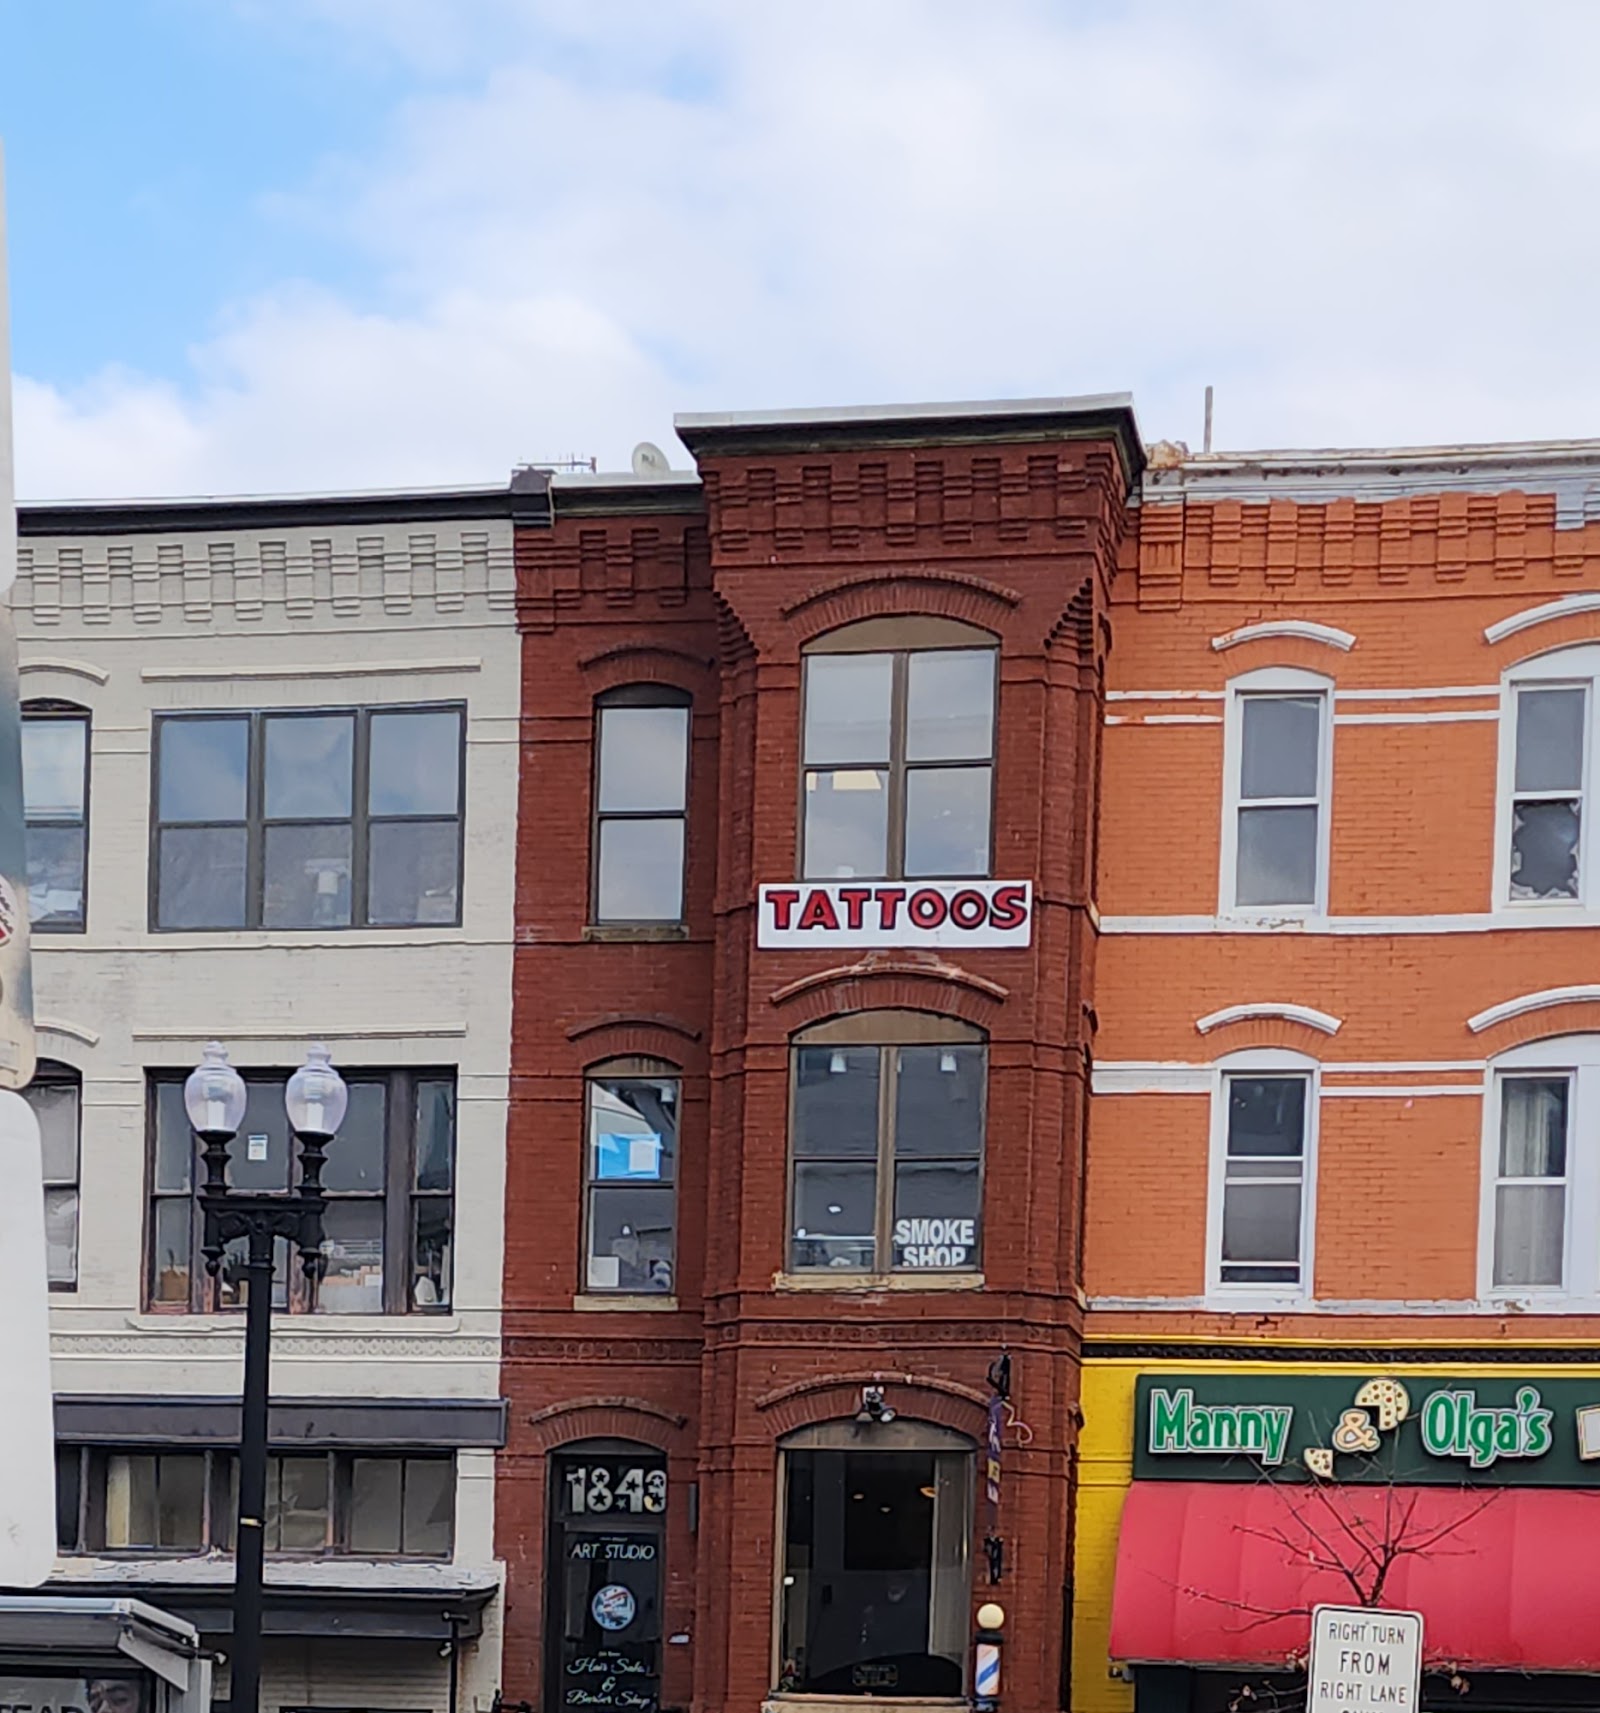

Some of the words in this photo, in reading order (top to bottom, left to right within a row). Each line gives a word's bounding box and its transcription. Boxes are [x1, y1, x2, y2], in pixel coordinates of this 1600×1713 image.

[766, 885, 1028, 930] TATTOOS
[892, 1218, 975, 1246] SMOKE
[902, 1246, 967, 1267] SHOP
[1148, 1388, 1293, 1465] Manny
[1332, 1408, 1380, 1453] &
[1421, 1386, 1554, 1468] Olga's
[566, 1467, 667, 1513] 1843
[571, 1543, 601, 1559] ART
[605, 1544, 655, 1560] STUDIO
[1329, 1622, 1367, 1642] RIGHT
[1371, 1625, 1406, 1644] TURN
[566, 1657, 608, 1674] Hair
[1340, 1650, 1391, 1676] FROM
[602, 1676, 616, 1692] &
[1320, 1681, 1362, 1701] RIGHT
[1370, 1685, 1407, 1704] LANE
[615, 1690, 650, 1710] Shop
